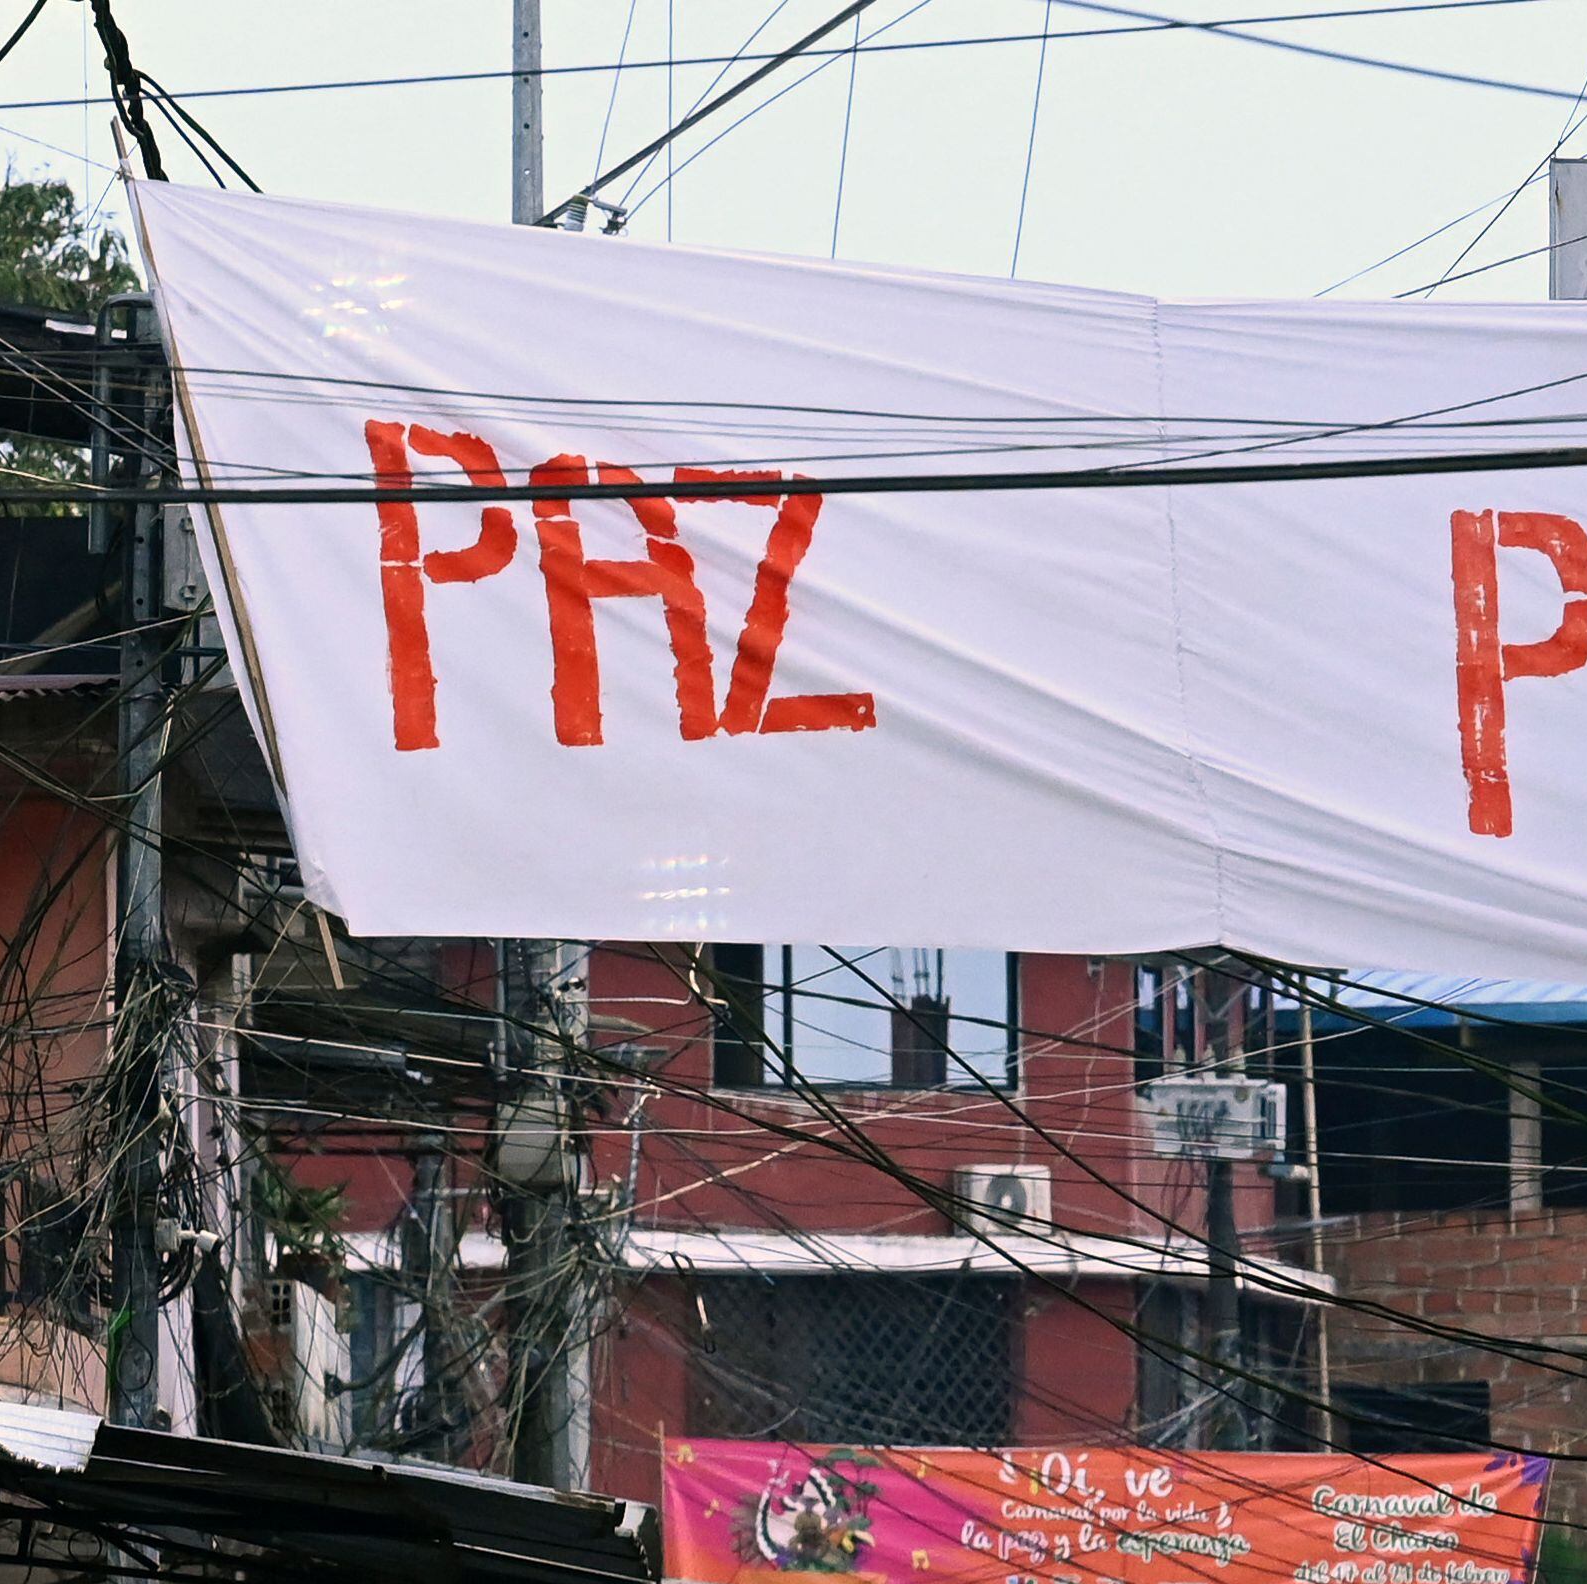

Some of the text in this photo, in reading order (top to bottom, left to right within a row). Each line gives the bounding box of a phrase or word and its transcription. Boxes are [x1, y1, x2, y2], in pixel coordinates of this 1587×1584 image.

[365, 419, 876, 751] PAZ
[1001, 1500, 1210, 1527] Carnaval por la vida
[1312, 1483, 1497, 1518] Carnaval de
[961, 1520, 1251, 1567] la paz y la esperanza
[1333, 1521, 1460, 1553] El Charco
[1294, 1560, 1330, 1584] del
[1362, 1561, 1387, 1584] al
[1416, 1561, 1442, 1584] de
